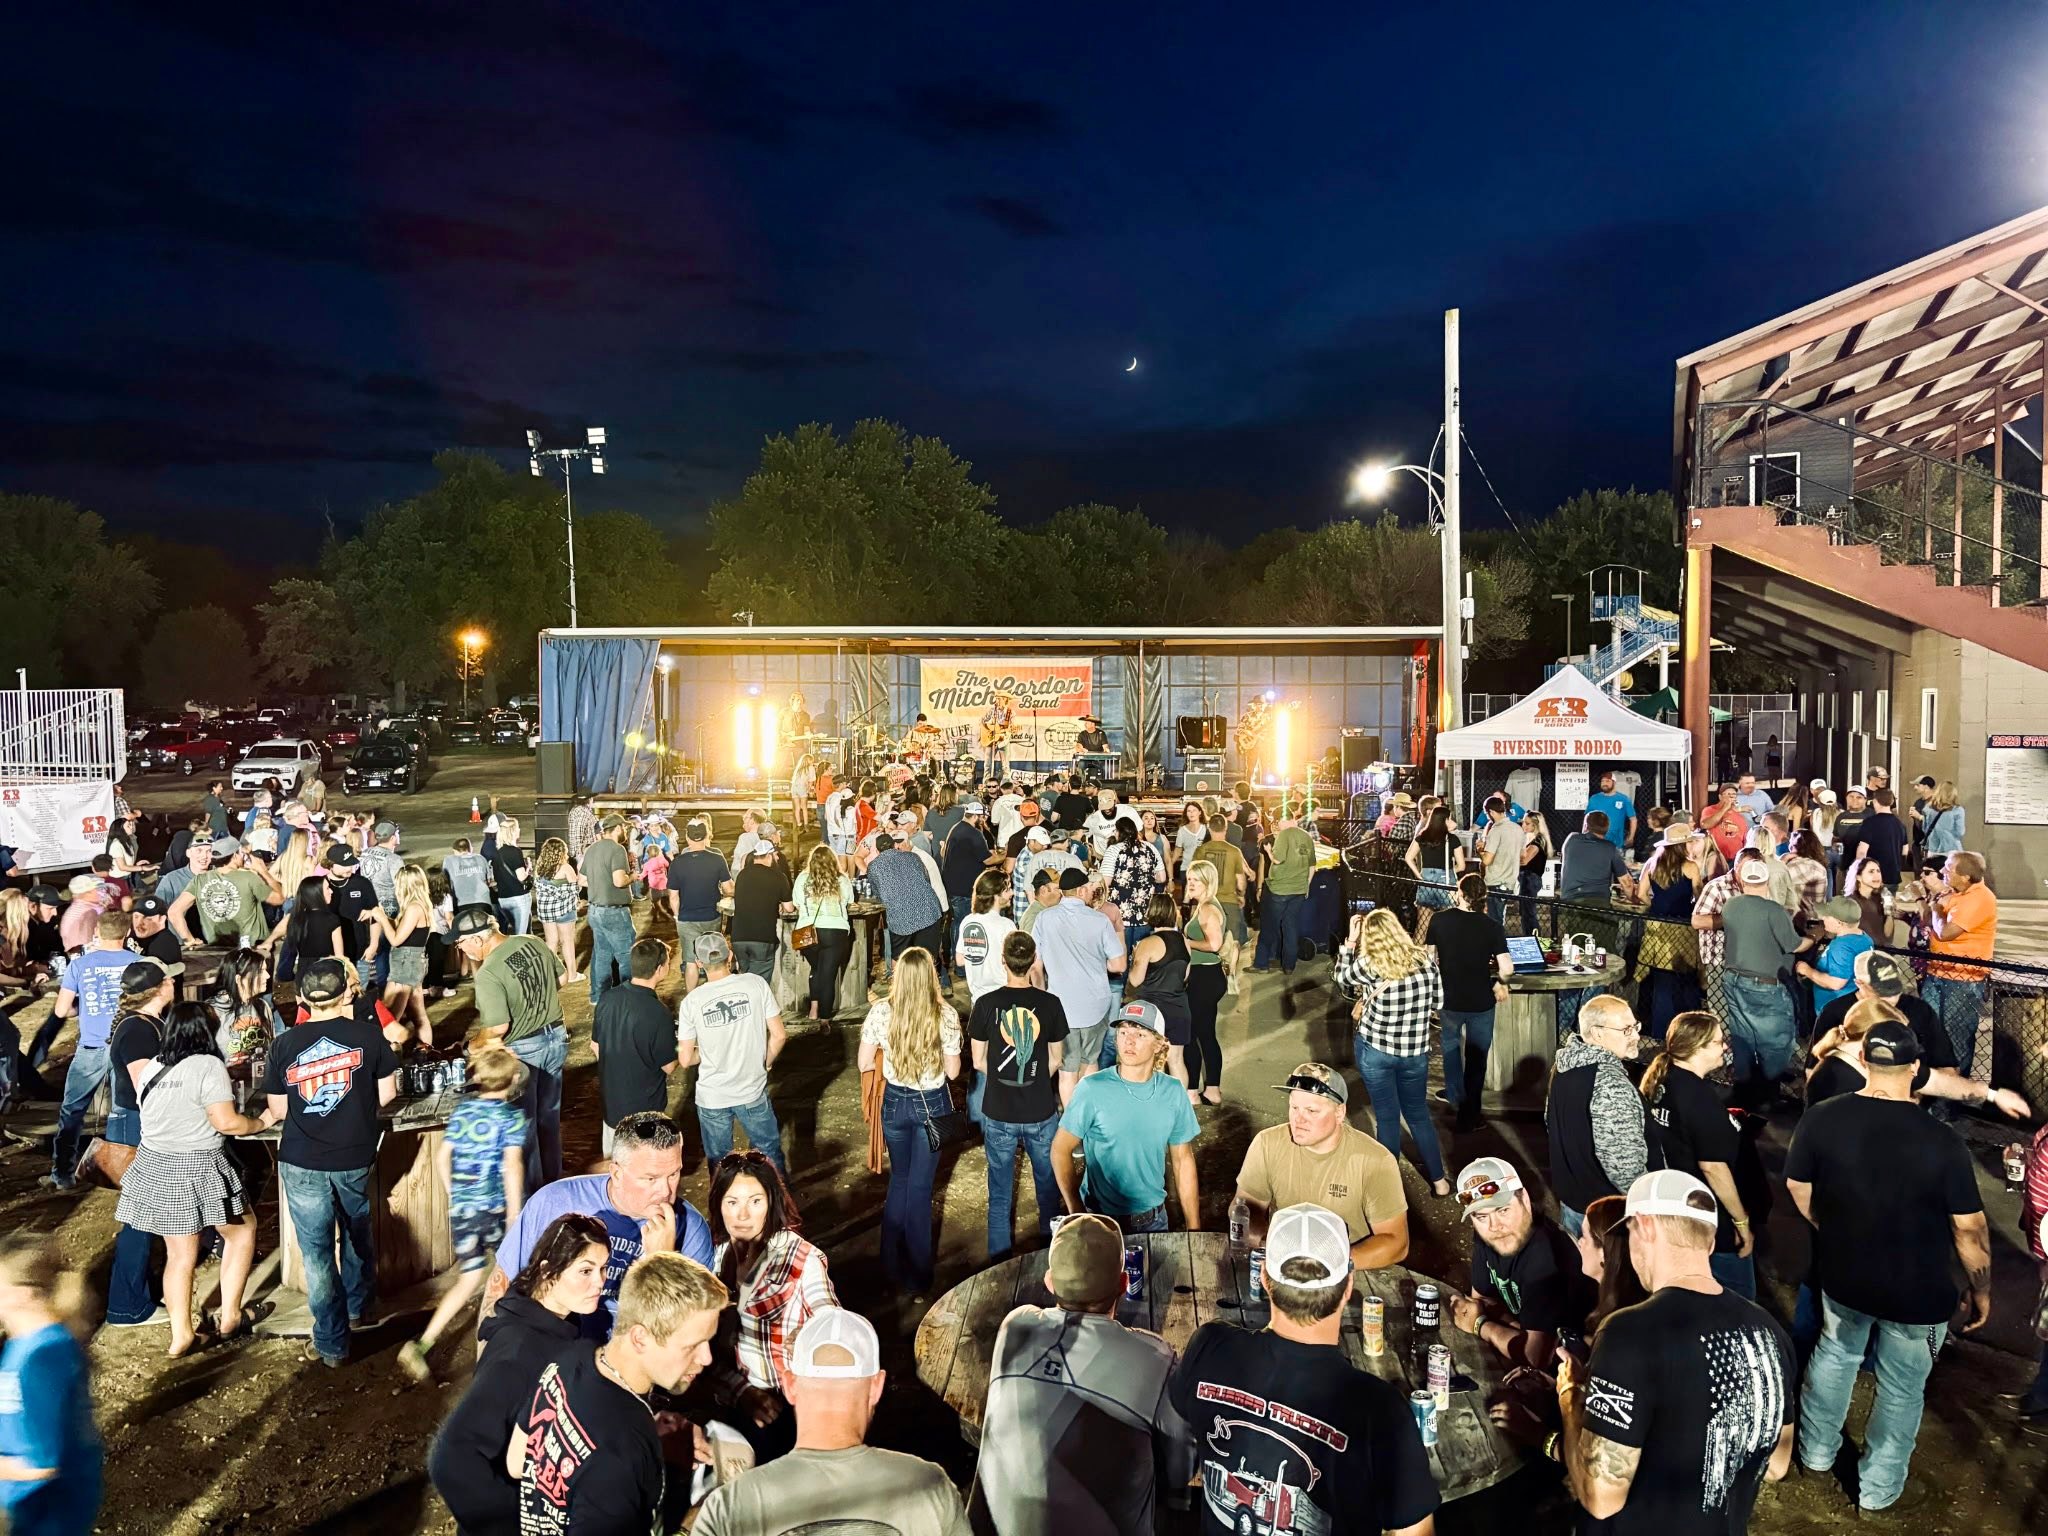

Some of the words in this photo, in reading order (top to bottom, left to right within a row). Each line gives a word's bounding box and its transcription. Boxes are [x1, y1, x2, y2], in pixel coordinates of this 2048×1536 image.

[956, 670, 990, 687] The
[929, 687, 997, 713] Mitch
[1019, 696, 1060, 709] Band
[1493, 740, 1567, 755] RIVERSIDE
[1574, 740, 1622, 755] RODEO
[297, 1056, 352, 1079] Snap-on
[1329, 1183, 1348, 1193] CINCH
[609, 1236, 636, 1255] SIDE
[1608, 1382, 1635, 1398] STYLE
[1603, 1415, 1630, 1430] DEFEND
